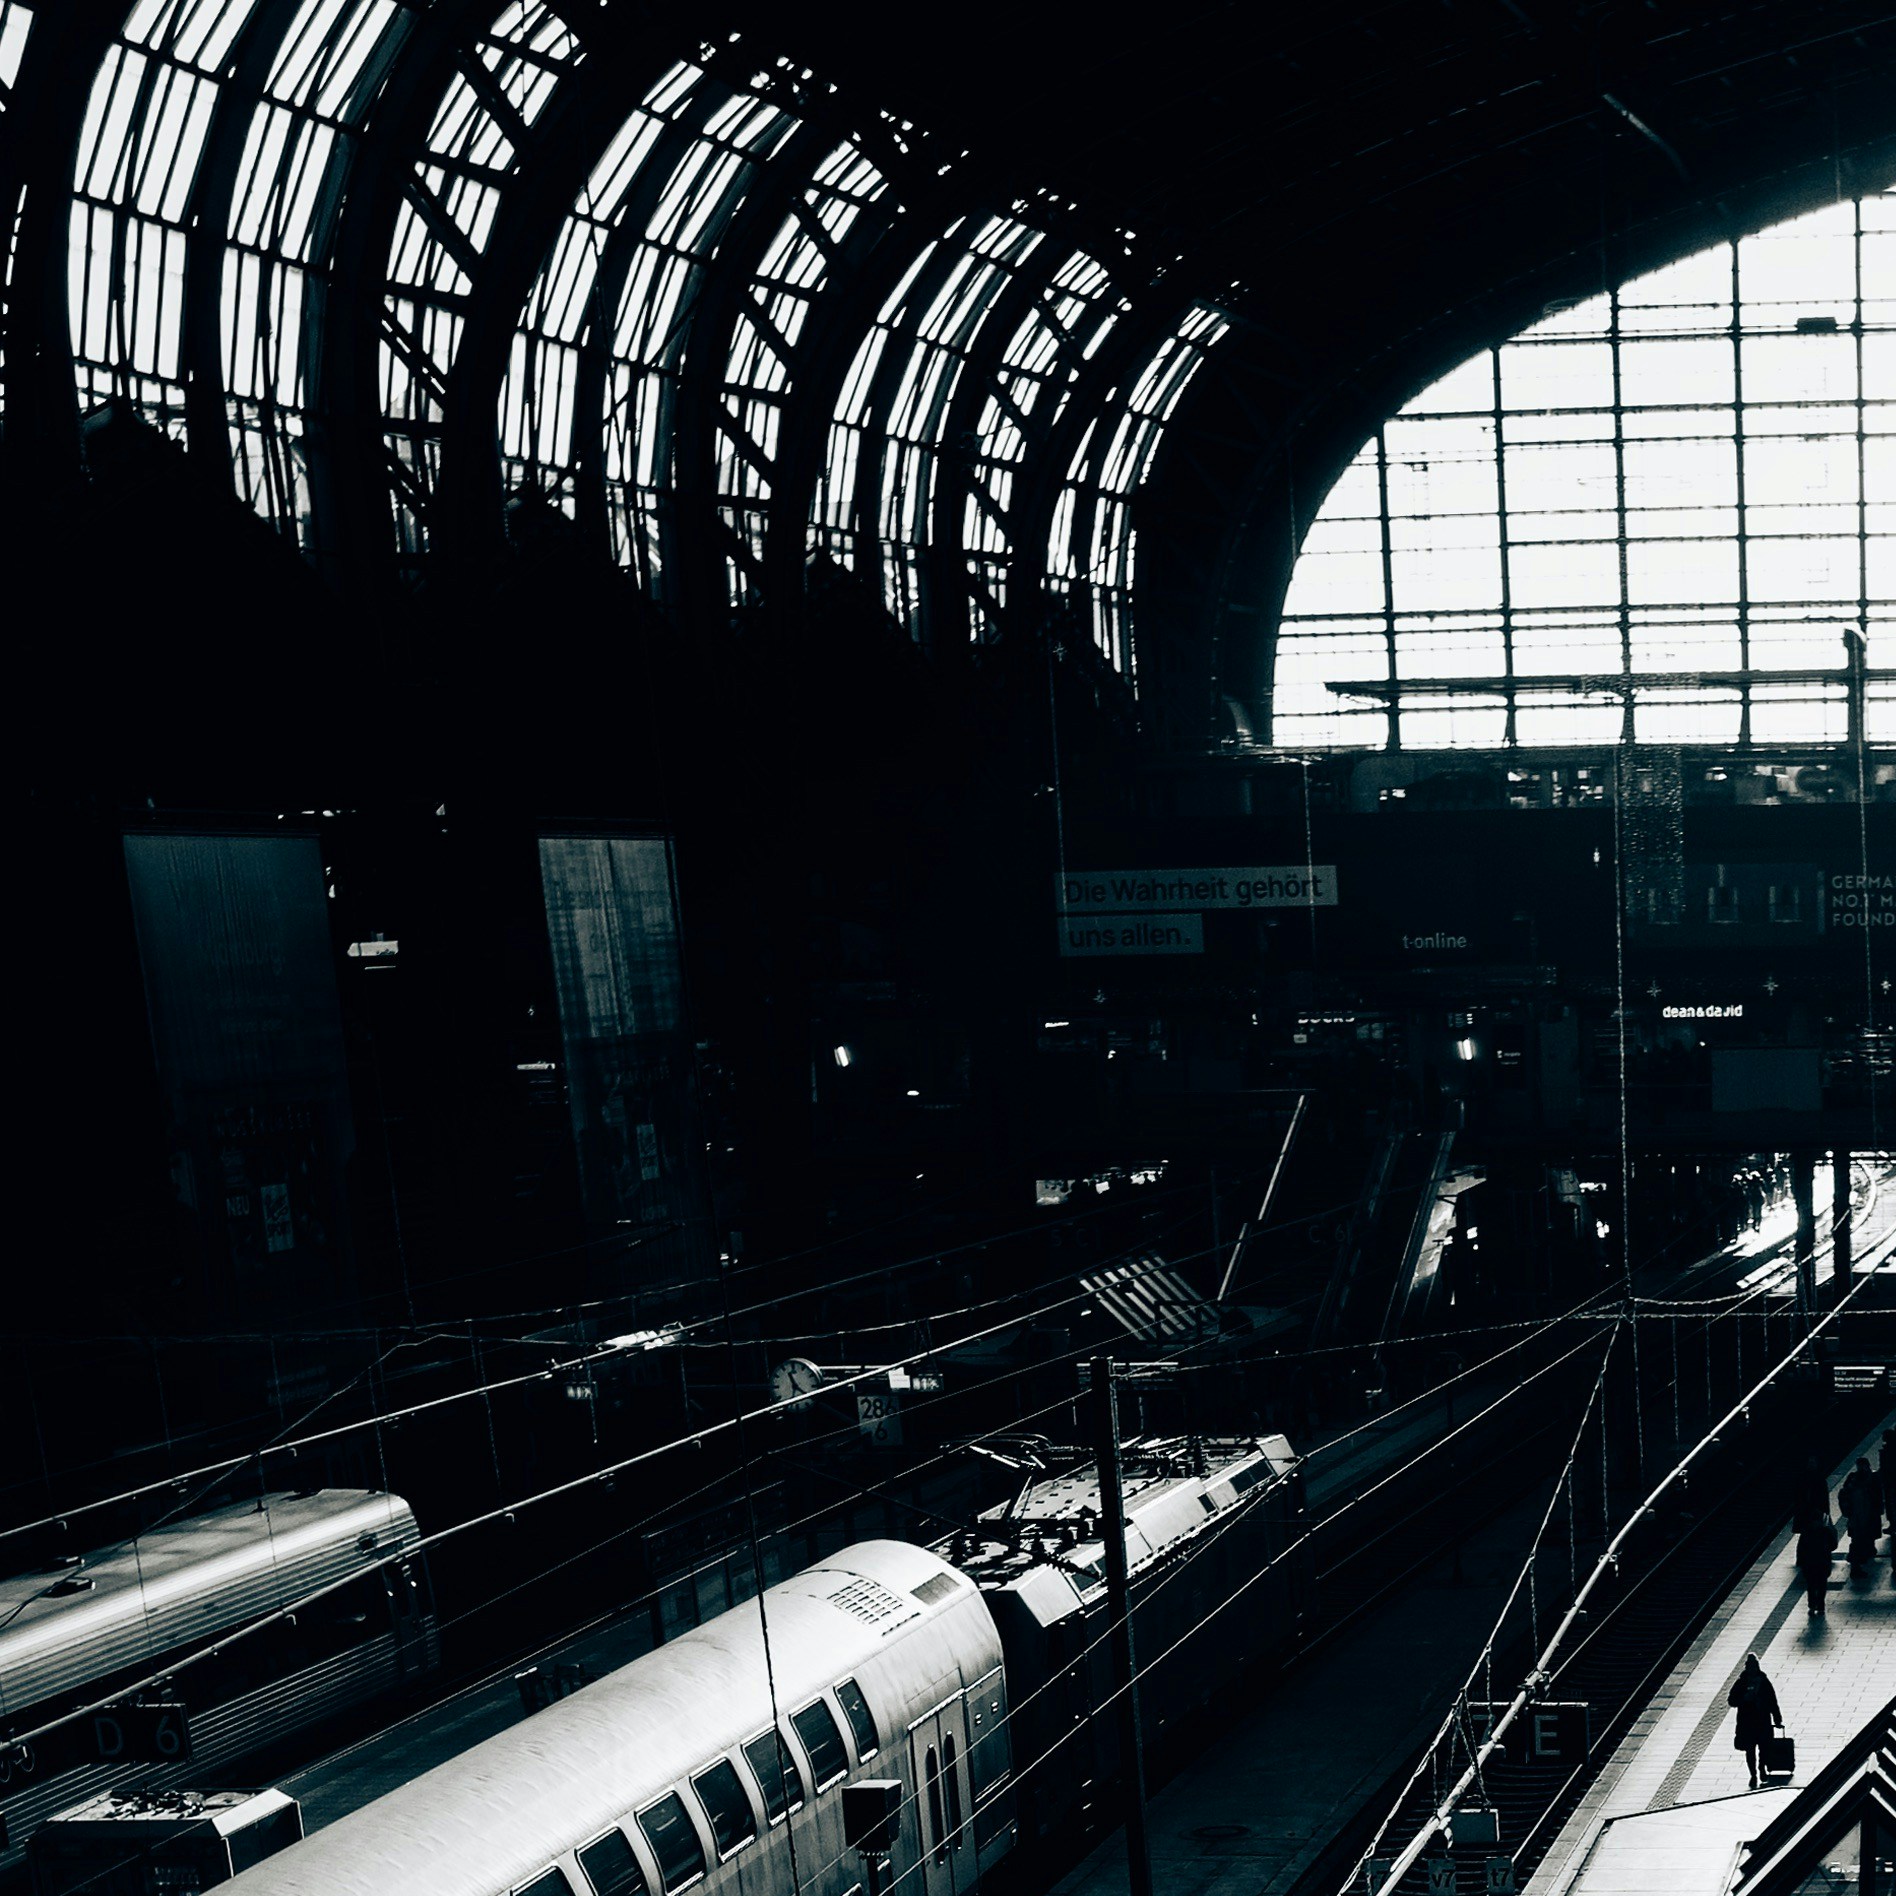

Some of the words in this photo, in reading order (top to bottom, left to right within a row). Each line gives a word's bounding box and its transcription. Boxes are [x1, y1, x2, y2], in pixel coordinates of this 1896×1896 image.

[1066, 879, 1107, 903] Die
[1110, 876, 1230, 902] Wahrheit
[1235, 873, 1323, 905] gehört
[1069, 927, 1117, 948] uns
[1120, 922, 1192, 947] allen.
[1402, 932, 1467, 949] t-online
[874, 1422, 889, 1442] 6
[94, 1716, 124, 1757] D
[154, 1714, 181, 1756] 6
[1534, 1714, 1562, 1756] E
